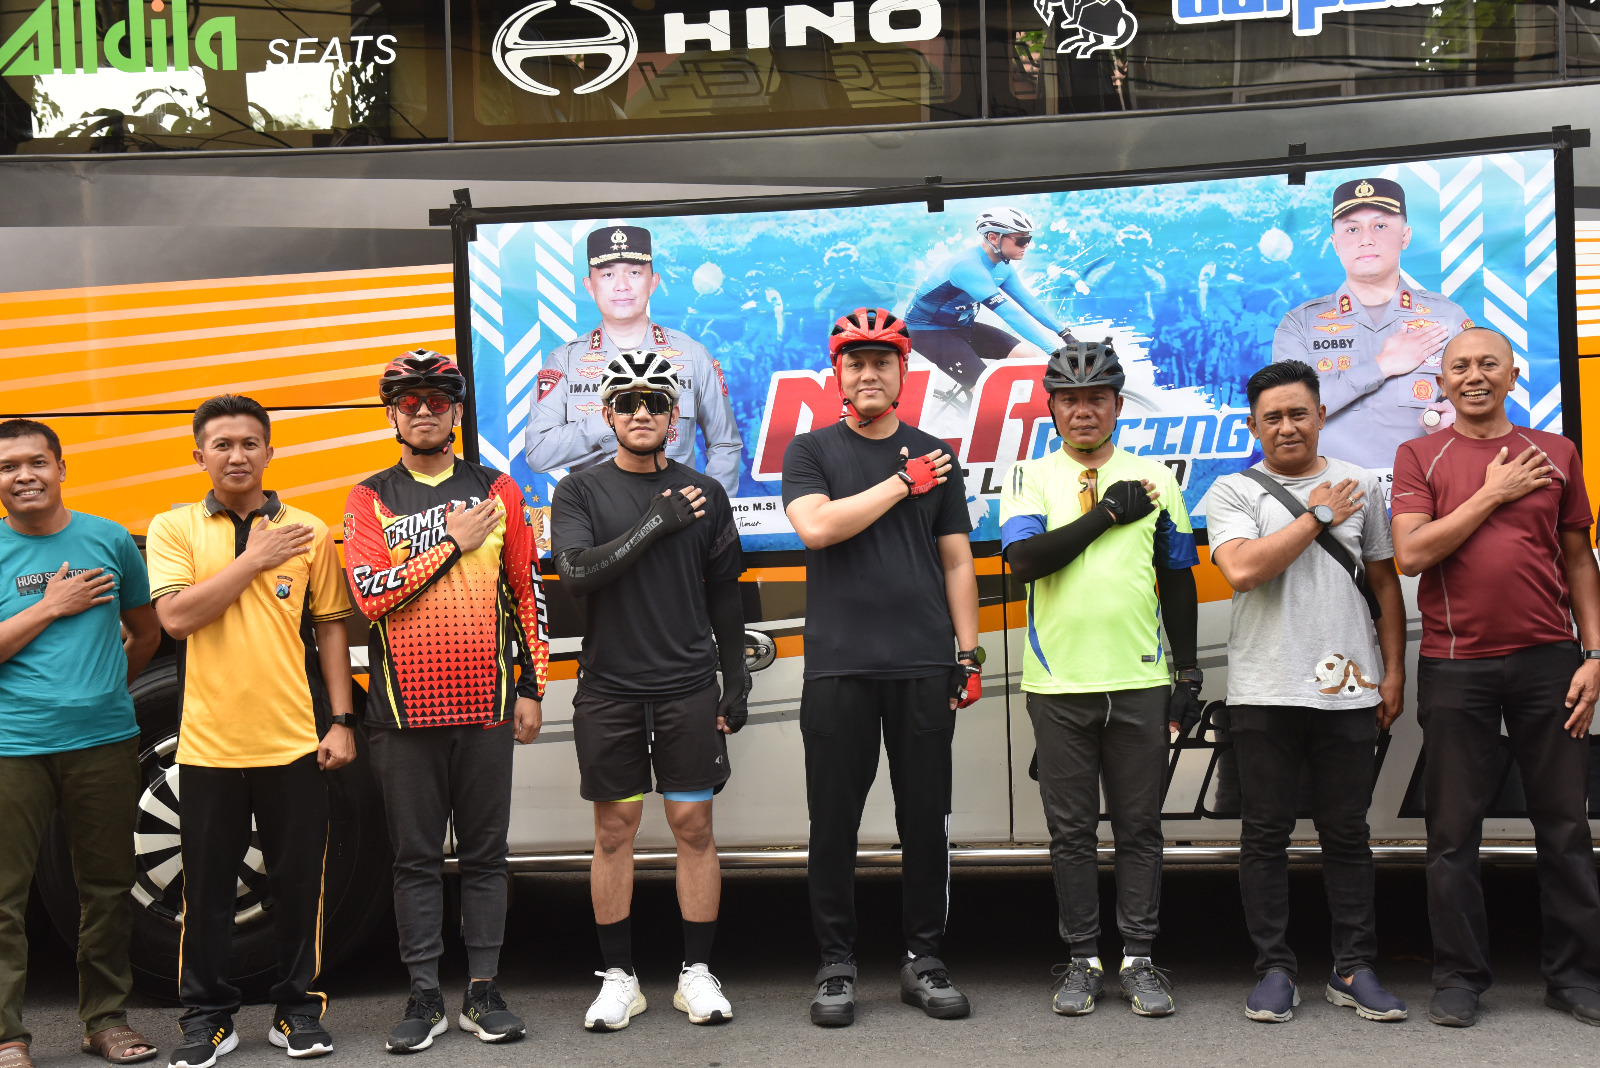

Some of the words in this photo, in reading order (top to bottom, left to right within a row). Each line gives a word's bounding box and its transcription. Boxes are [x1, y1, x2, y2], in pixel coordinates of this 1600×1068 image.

[664, 0, 942, 54] HINO
[267, 35, 398, 66] SEATS
[1313, 339, 1354, 350] BOBBY
[1032, 414, 1254, 459] RCING
[753, 502, 776, 511] M.Si
[384, 503, 447, 549] CRIME
[17, 573, 43, 587] HUGO
